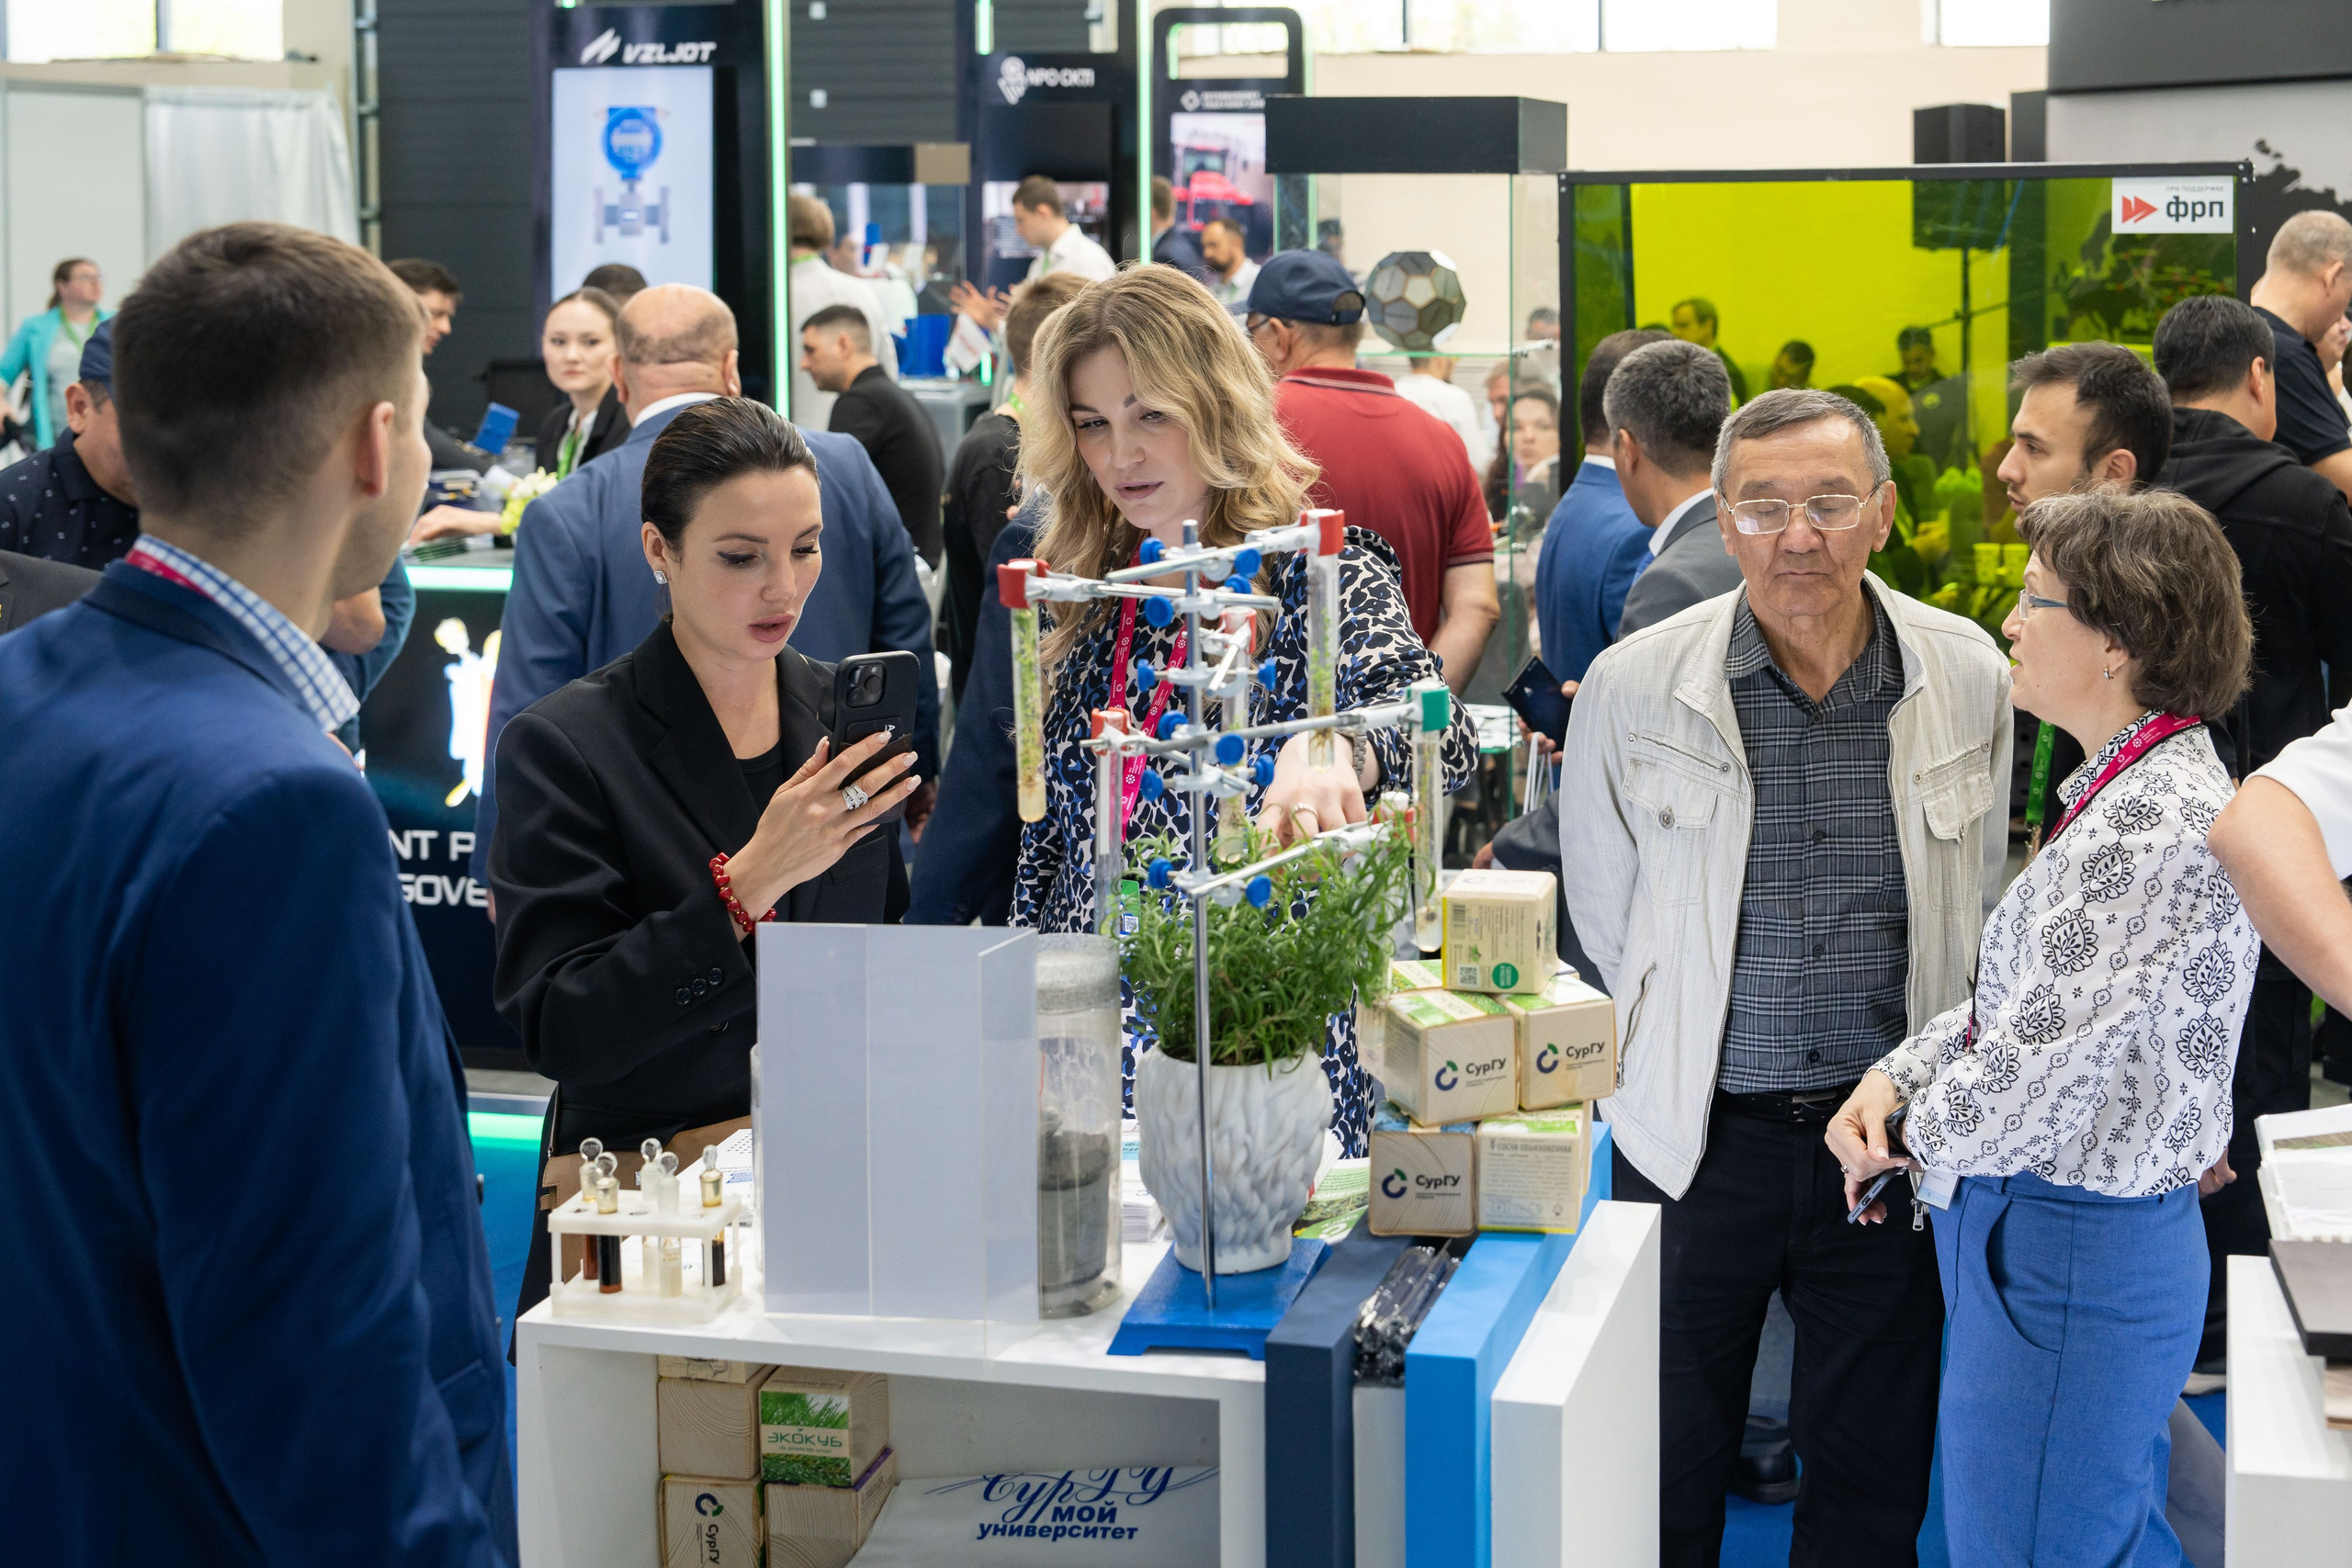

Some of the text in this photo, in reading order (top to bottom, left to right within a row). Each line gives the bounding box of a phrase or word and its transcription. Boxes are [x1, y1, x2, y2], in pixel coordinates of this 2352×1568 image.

[622, 41, 718, 64] VZLJOT
[2165, 195, 2223, 222] фрп
[1566, 1041, 1606, 1059] СурГУ
[1465, 1057, 1507, 1077] СурГУ
[1415, 1174, 1461, 1190] СурГУ
[767, 1430, 843, 1449] ЭКОКУБ
[977, 1522, 1138, 1541] университет
[706, 1523, 720, 1566] СурГУ
